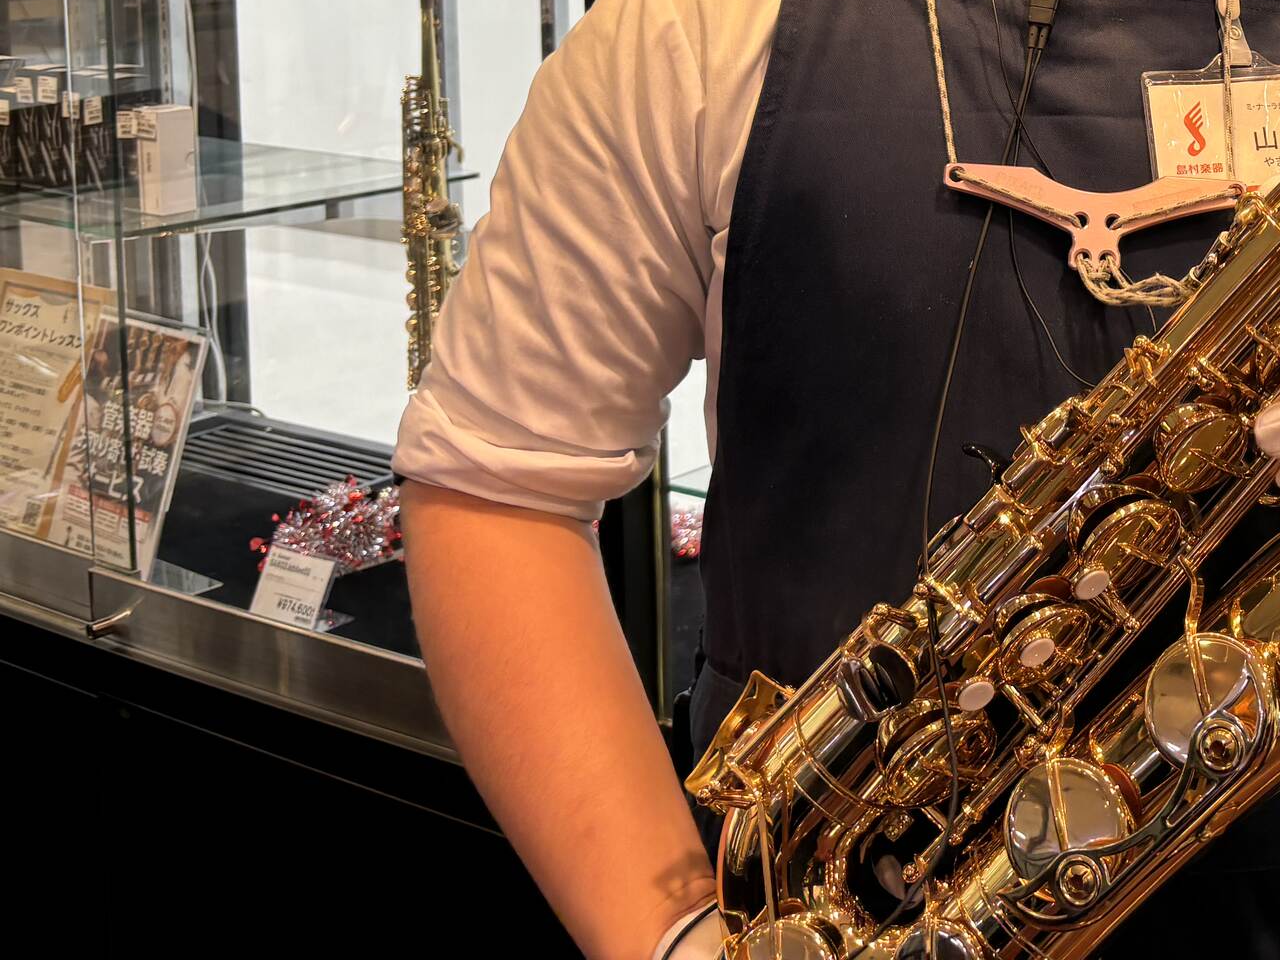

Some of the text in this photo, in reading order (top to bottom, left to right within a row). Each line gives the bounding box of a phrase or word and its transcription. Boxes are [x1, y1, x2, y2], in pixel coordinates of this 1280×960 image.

[1176, 162, 1224, 175] 島村楽器
[6, 299, 41, 318] サックス
